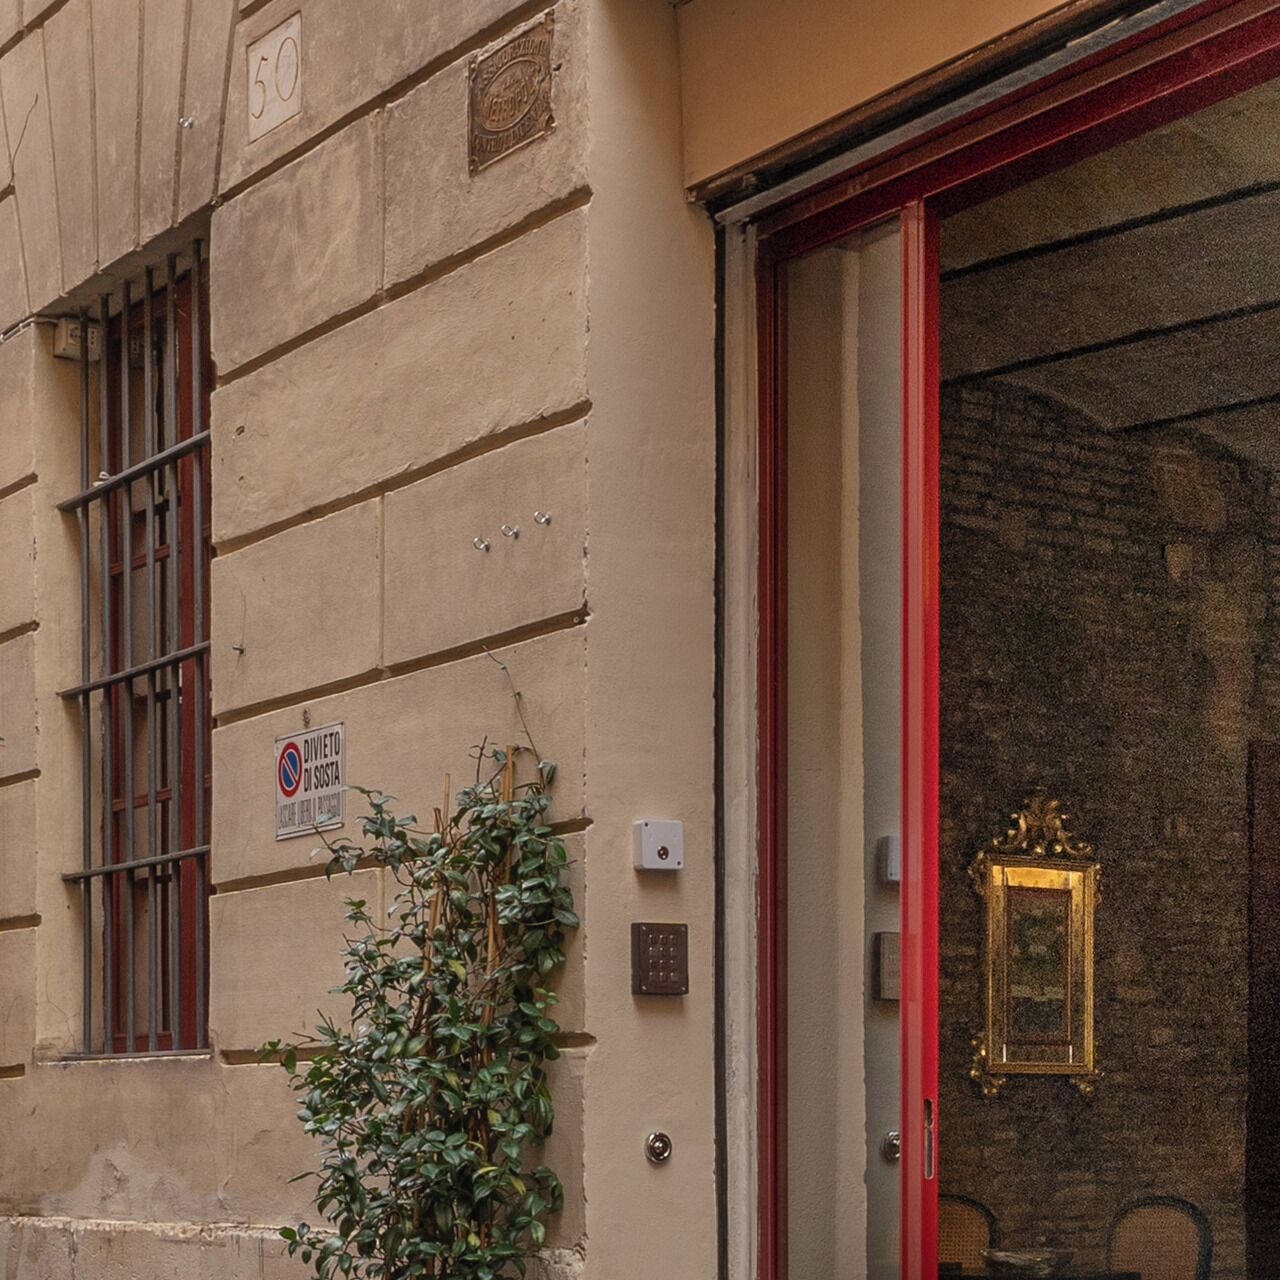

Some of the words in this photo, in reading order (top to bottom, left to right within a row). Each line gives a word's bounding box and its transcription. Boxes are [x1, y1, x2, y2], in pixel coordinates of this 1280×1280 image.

[250, 36, 299, 120] 50
[303, 731, 340, 764] DIVIETO
[304, 768, 312, 792] DI
[314, 761, 340, 790] SOSTA
